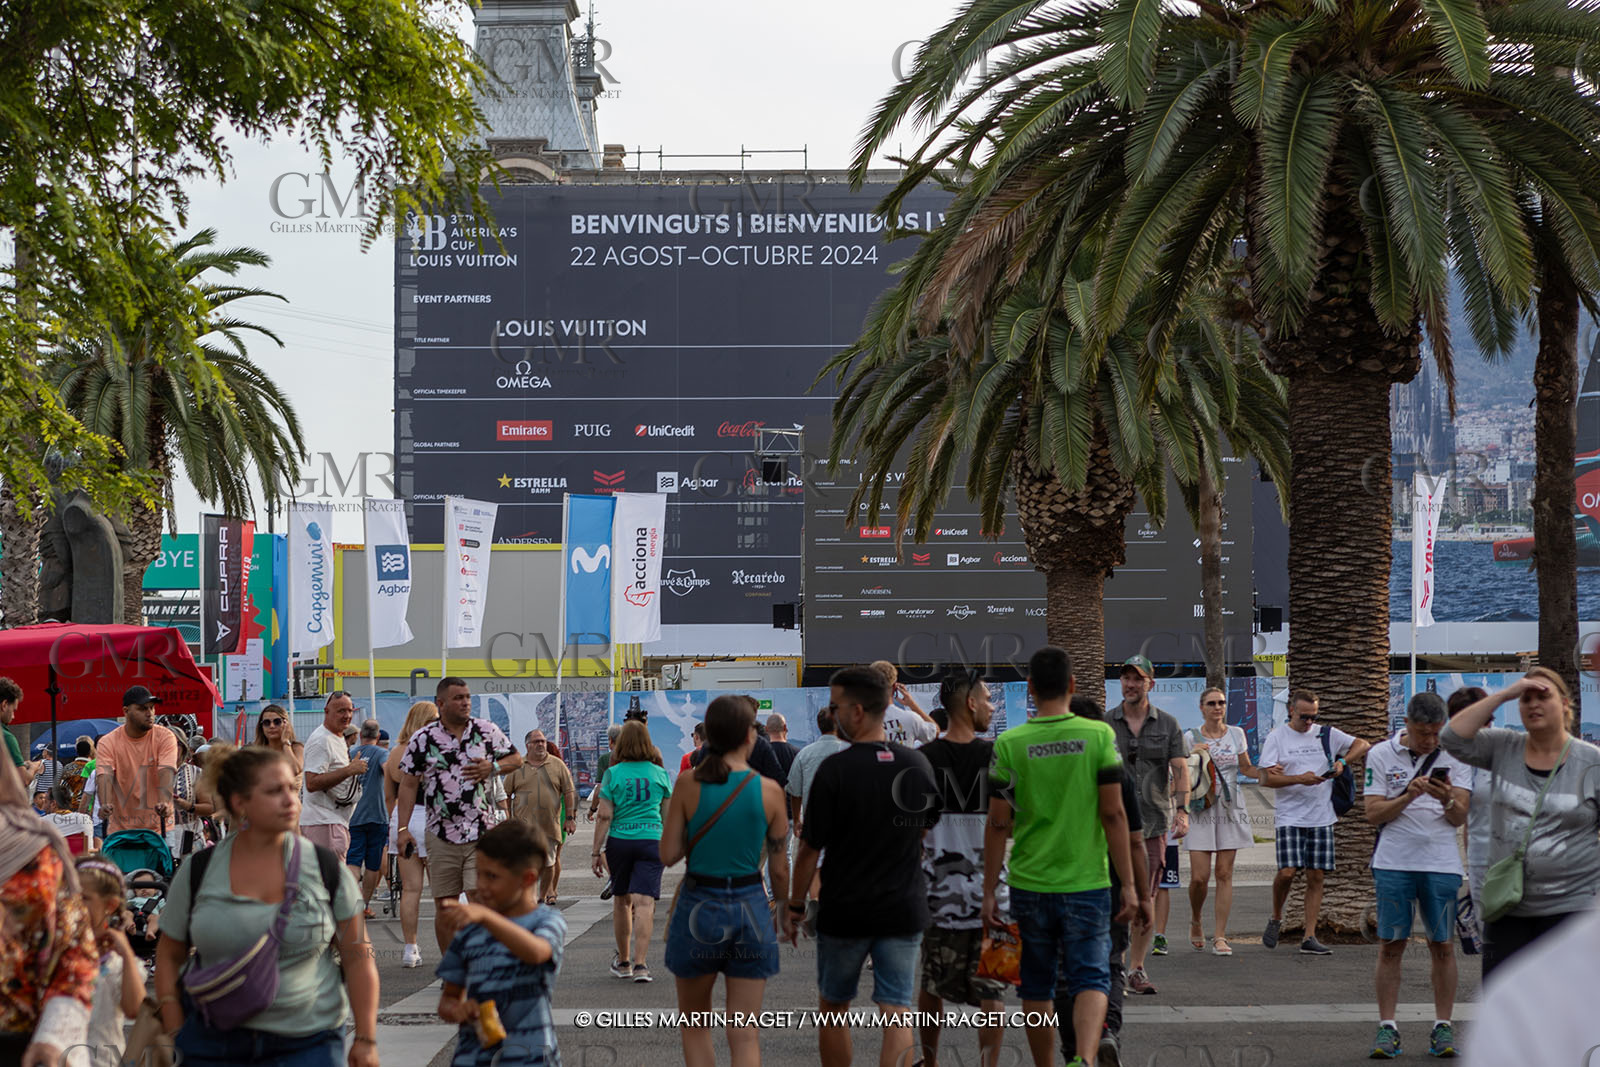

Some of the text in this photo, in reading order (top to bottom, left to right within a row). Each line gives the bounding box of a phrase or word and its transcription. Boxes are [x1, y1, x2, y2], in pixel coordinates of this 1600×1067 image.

[571, 214, 730, 234] BENVINGUTS
[750, 214, 918, 233] BIENVENIDOS
[451, 228, 518, 238] AMERIA'S
[451, 241, 476, 250] CUP
[410, 254, 518, 266] LOUIS VUITTON
[570, 246, 596, 266] 22
[820, 245, 878, 265] 2024
[413, 296, 492, 304] EVENT PARTNERS
[496, 320, 646, 336] LOUIS VUITTON
[496, 376, 552, 388] OMEGA
[502, 426, 548, 436] Emirates
[574, 424, 612, 437] PUIG
[648, 424, 695, 436] UniCredit
[717, 420, 764, 438] Coca-Co
[514, 478, 568, 488] ESTRELLA
[680, 477, 718, 490] Agbar
[1425, 495, 1433, 574] YAN
[155, 551, 194, 567] BYE
[632, 528, 648, 590] acciona
[219, 527, 229, 612] CUPRA
[307, 544, 329, 633] Capgemini
[378, 584, 410, 596] Agbar
[162, 606, 189, 614] NEW
[1028, 741, 1085, 758] POSTOBON
[625, 778, 634, 800] TEAM
